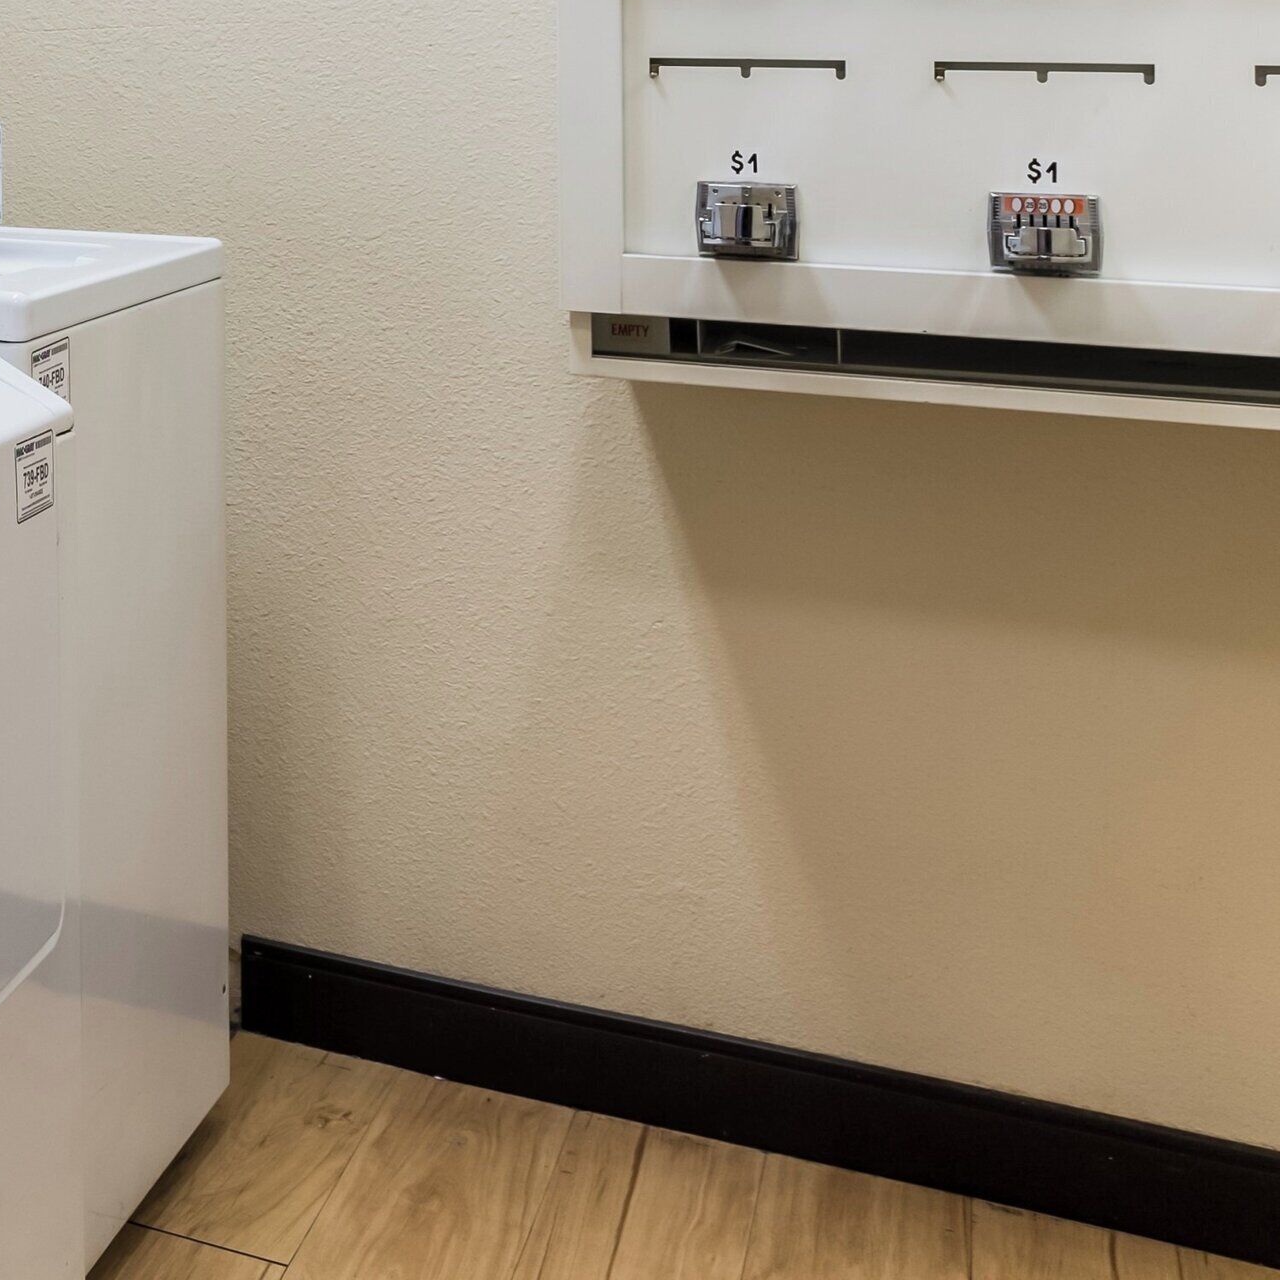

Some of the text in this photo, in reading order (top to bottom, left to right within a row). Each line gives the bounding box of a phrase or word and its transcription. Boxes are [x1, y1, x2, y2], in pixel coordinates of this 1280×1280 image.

[730, 150, 759, 174] $1
[1027, 158, 1057, 184] $1
[611, 323, 649, 337] EMPTY
